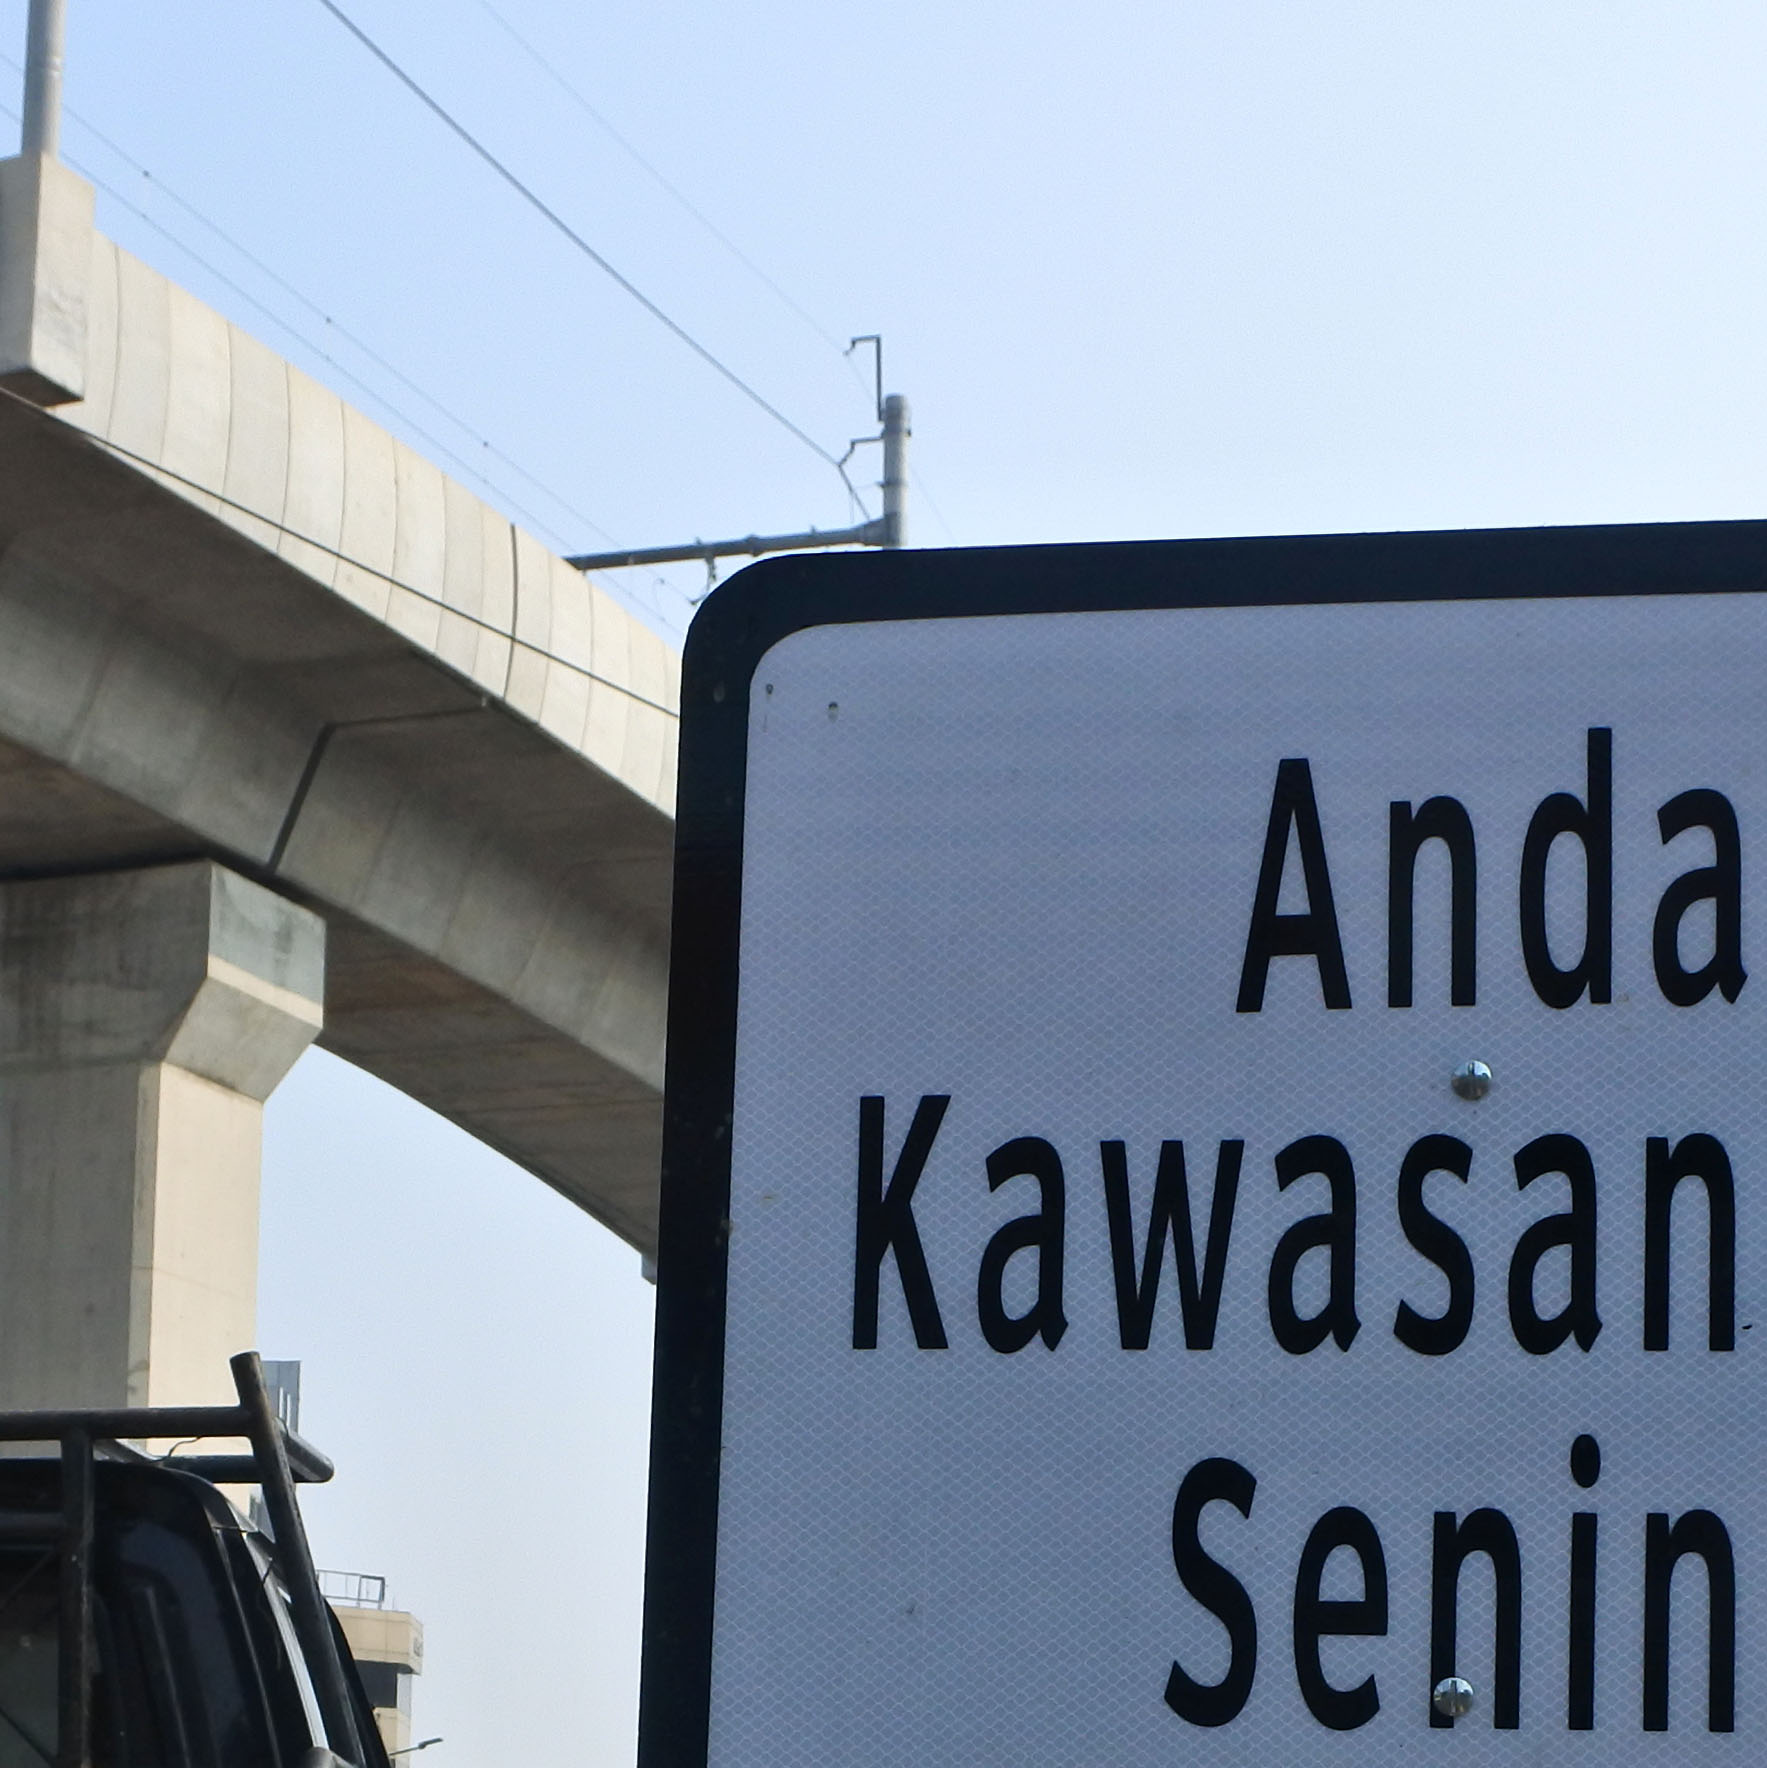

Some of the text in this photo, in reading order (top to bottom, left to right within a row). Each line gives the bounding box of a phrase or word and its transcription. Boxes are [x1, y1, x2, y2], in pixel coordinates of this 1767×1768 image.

[1234, 726, 1748, 1014] Anda
[850, 1094, 1738, 1357] Kawasan
[1160, 1431, 1739, 1738] Senin
